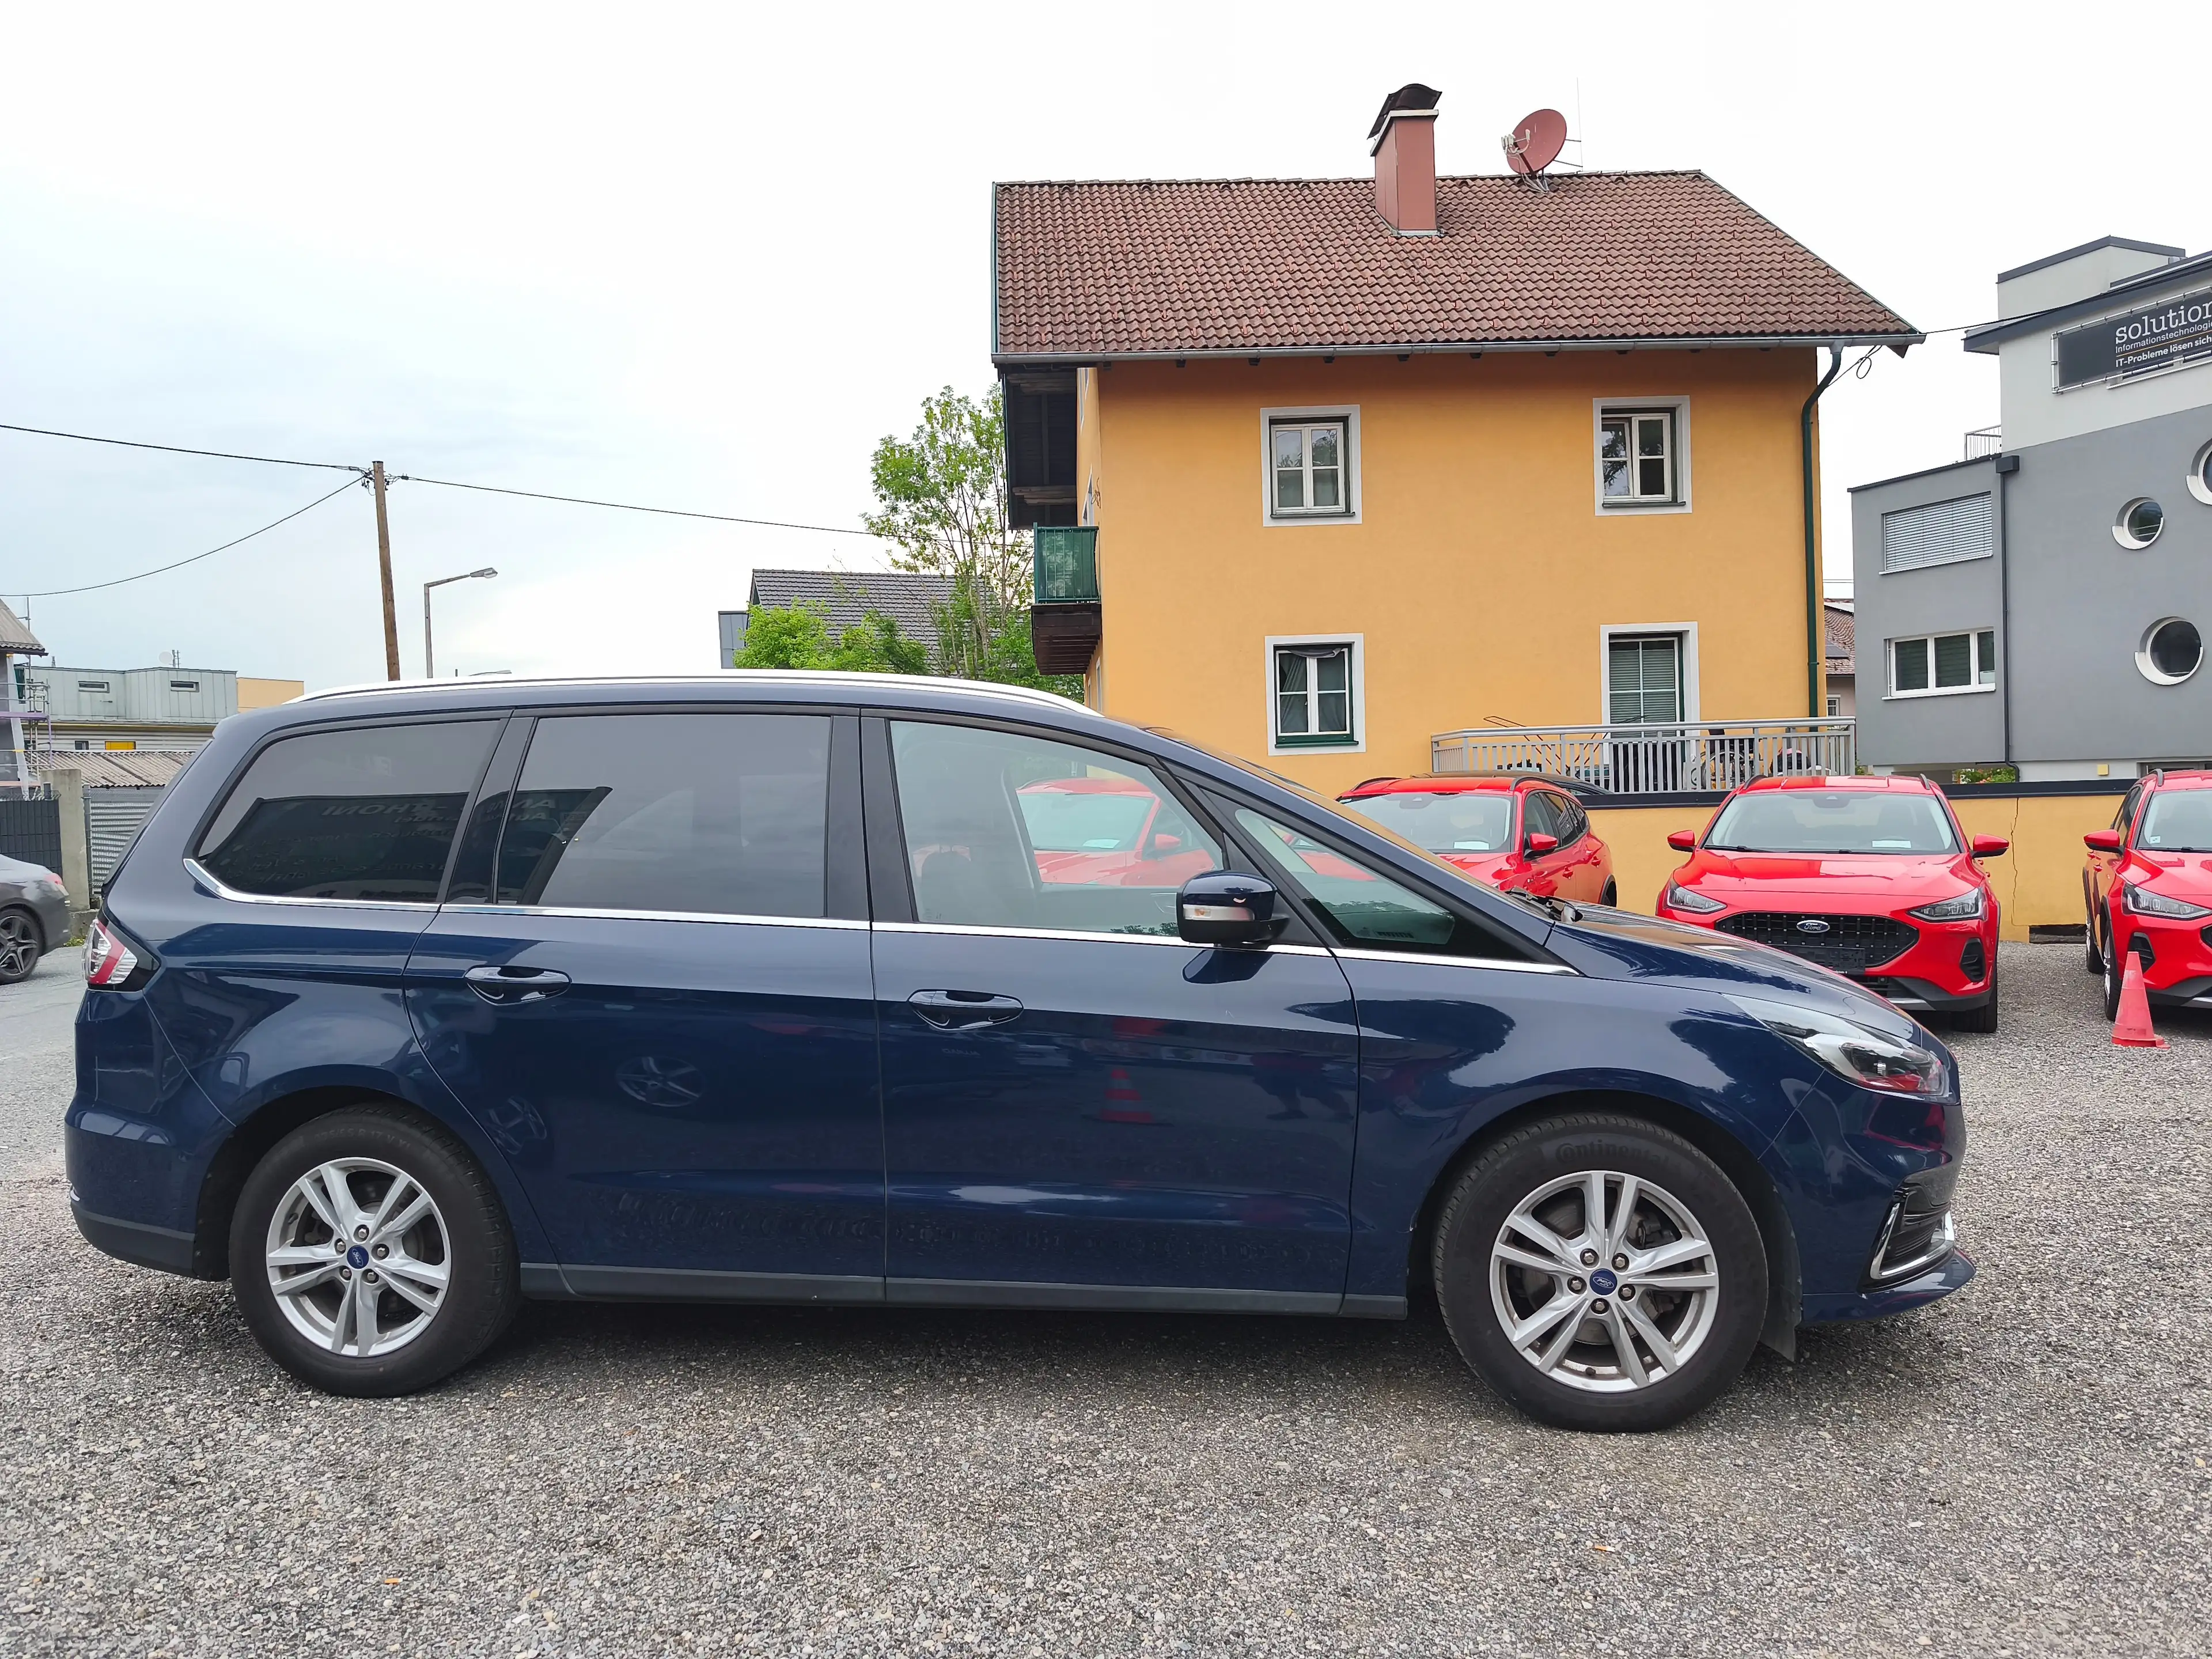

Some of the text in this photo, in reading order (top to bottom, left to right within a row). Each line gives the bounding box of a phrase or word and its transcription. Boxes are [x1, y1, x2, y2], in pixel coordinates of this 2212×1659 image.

[2116, 320, 2212, 353] Informationstechnologi
[2116, 335, 2212, 368] IT-Probleme lösen sich
[1804, 922, 1822, 930] Ford
[1556, 1139, 1669, 1164] Continental
